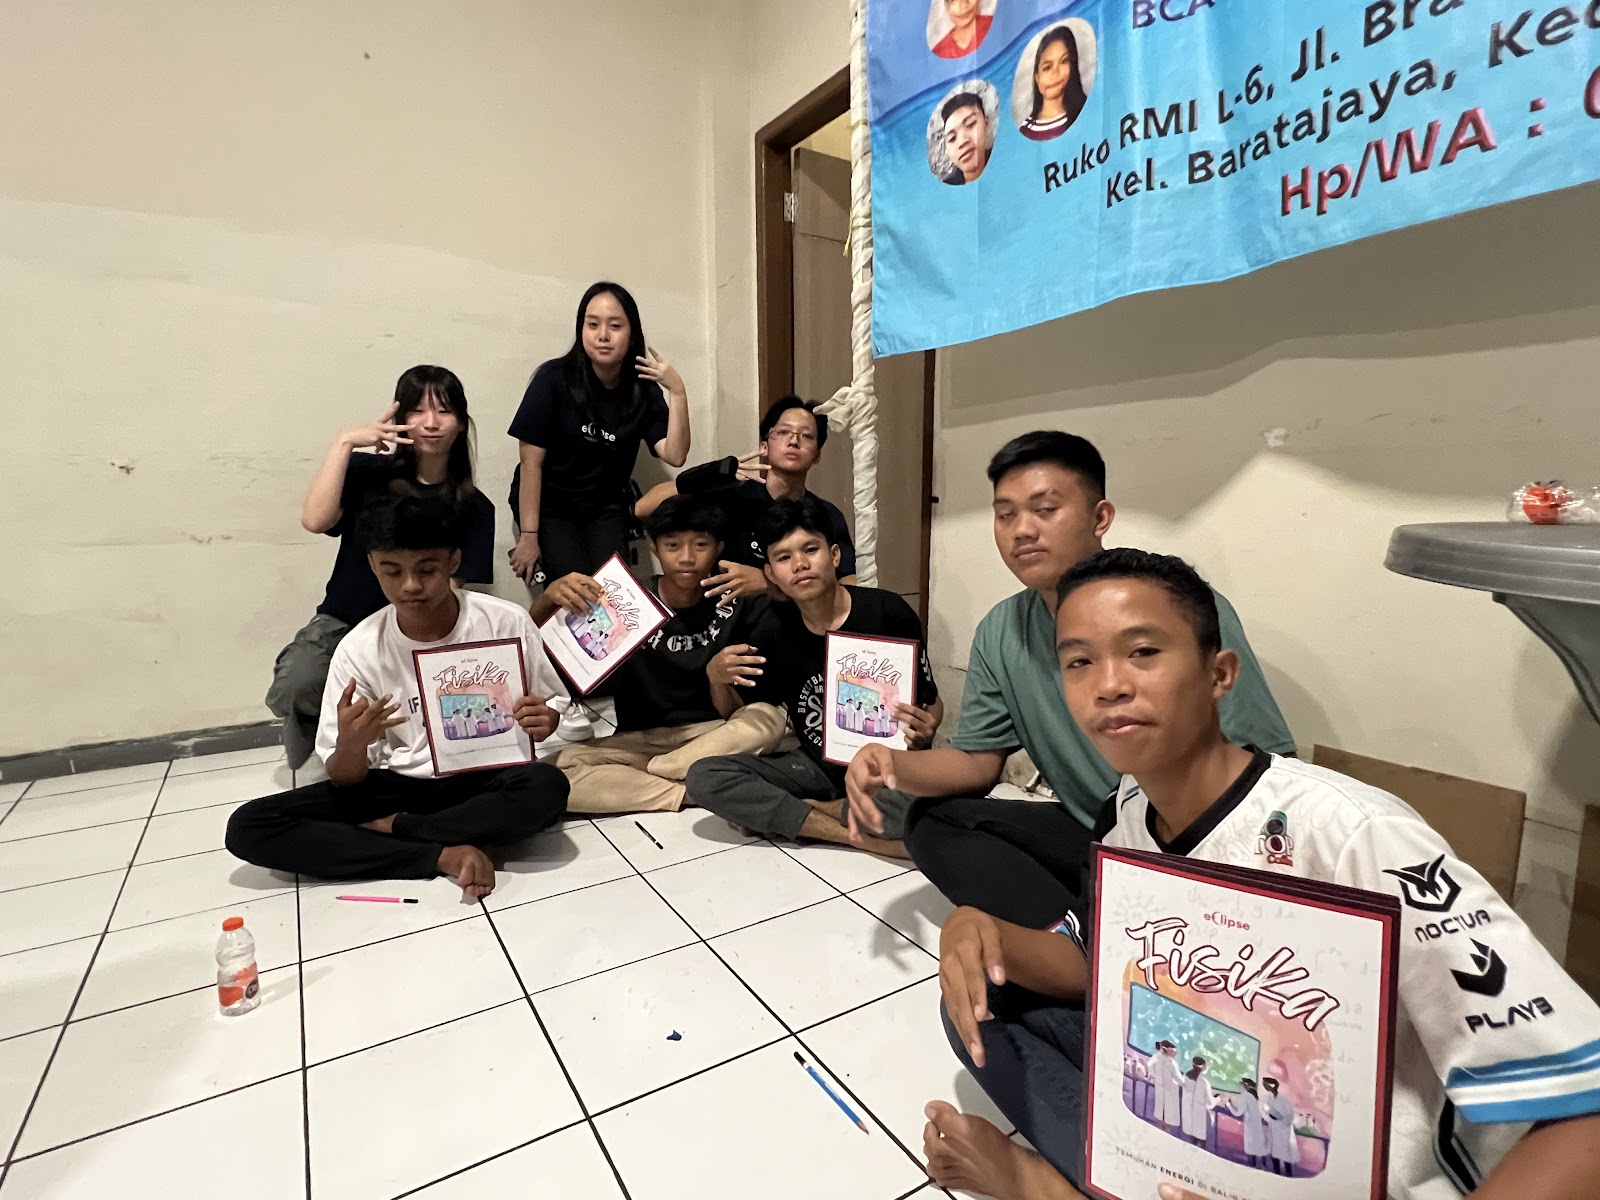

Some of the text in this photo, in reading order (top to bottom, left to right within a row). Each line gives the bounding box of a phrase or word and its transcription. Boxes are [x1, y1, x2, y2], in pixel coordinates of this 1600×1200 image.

[1043, 138, 1110, 194] Ruko
[1120, 99, 1199, 150] RMI
[1106, 157, 1169, 208] Kel.
[1188, 58, 1457, 184] Baratajaya,
[1281, 106, 1498, 217] Hp/WA
[433, 661, 510, 695] Fisika
[836, 652, 902, 686] Fisika
[1414, 909, 1491, 943] NOCTUA
[1125, 916, 1341, 1032] Fisika
[1115, 1146, 1156, 1170] TEMUKAN
[1160, 1166, 1194, 1185] ENERGI
